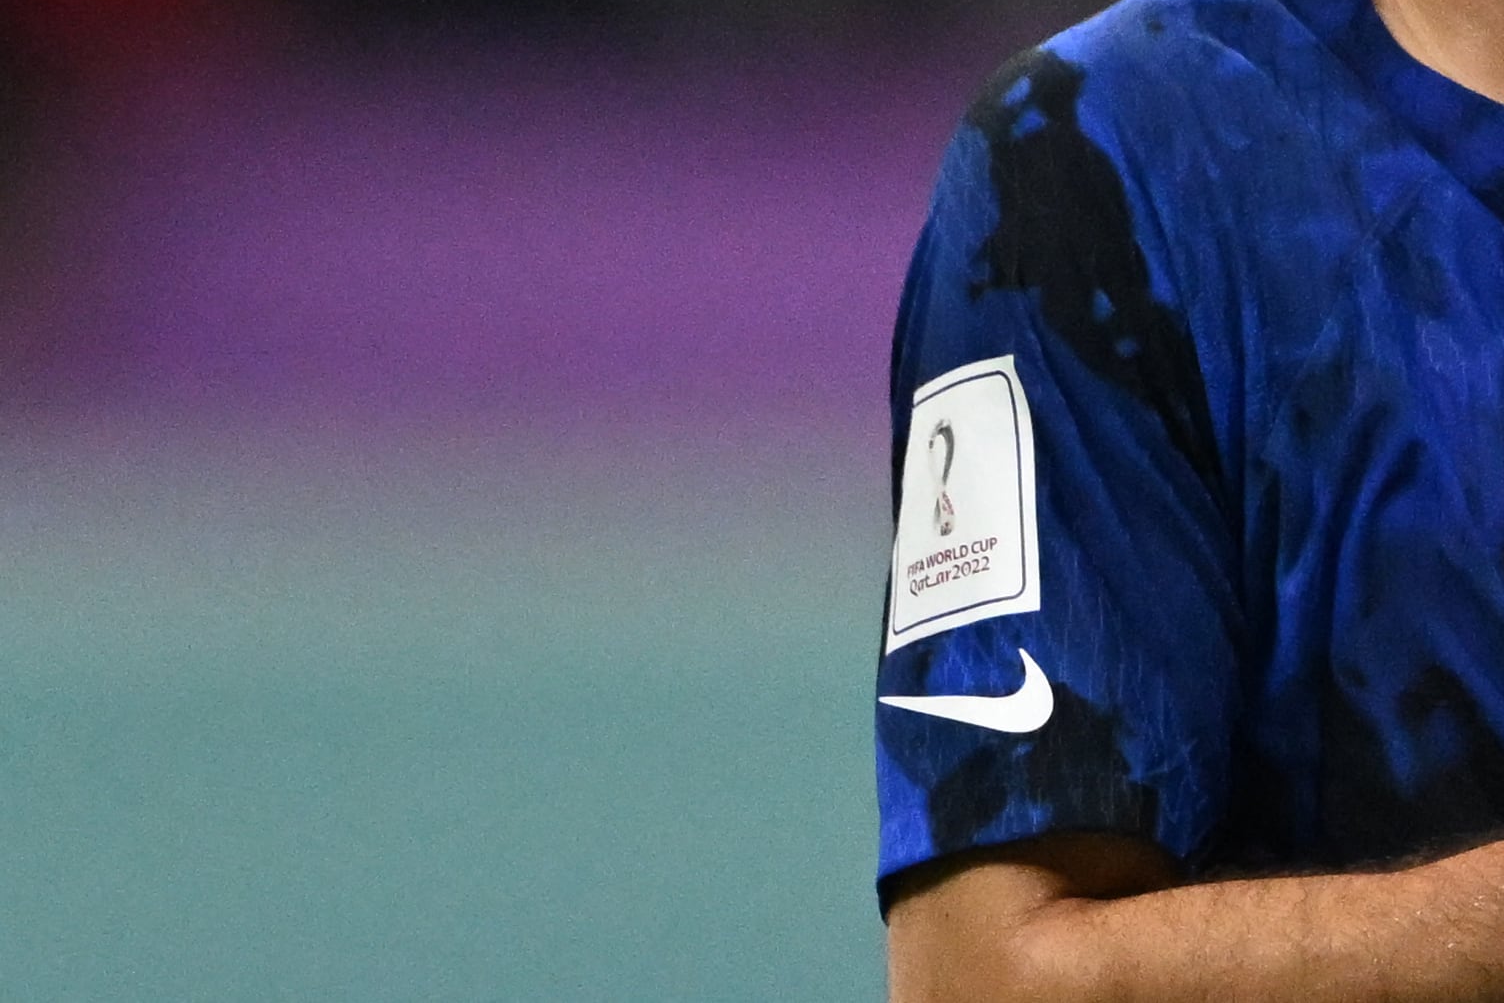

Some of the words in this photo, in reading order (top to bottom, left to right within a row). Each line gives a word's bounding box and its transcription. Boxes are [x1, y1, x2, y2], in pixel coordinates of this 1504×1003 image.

[907, 559, 926, 579] FIFA
[926, 544, 969, 569] WORLD
[971, 537, 998, 554] CUP
